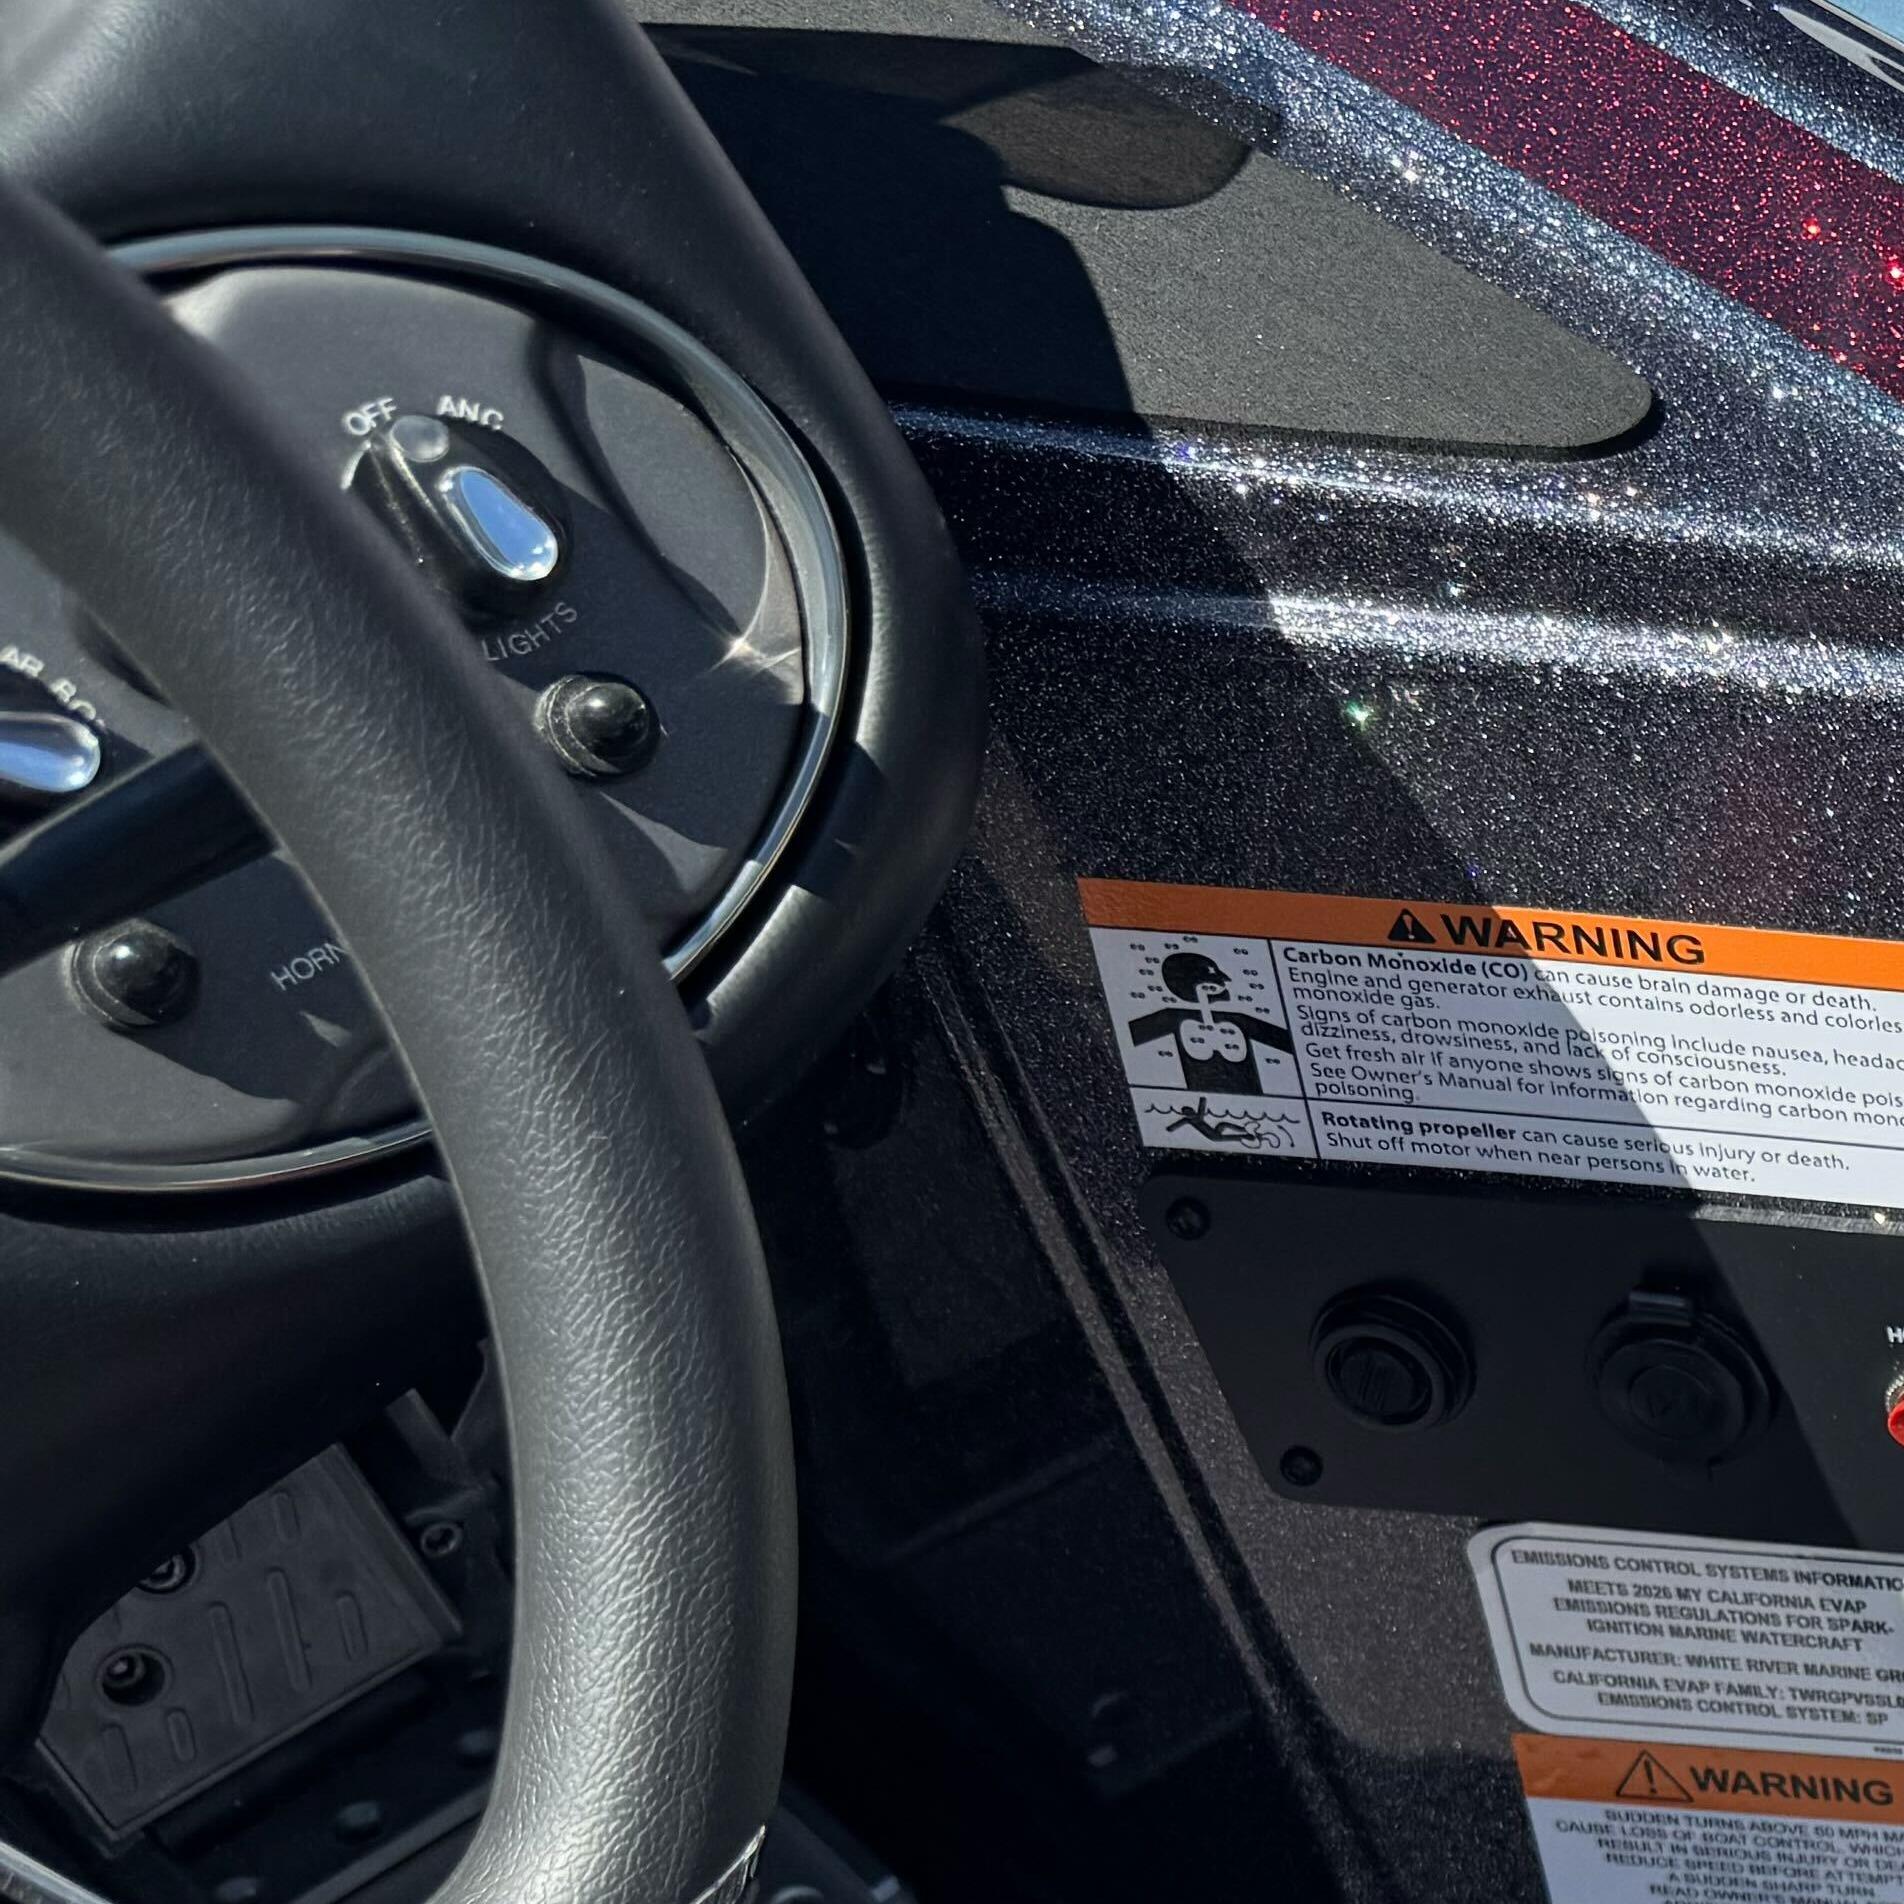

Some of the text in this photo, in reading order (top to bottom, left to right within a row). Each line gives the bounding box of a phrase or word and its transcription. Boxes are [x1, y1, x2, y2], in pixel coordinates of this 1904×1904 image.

[342, 397, 397, 435] OFF
[481, 602, 577, 661] LIGHTS
[1440, 914, 1705, 965] WARNING
[1281, 945, 1876, 1010] Carbon Monoxide (CO) can cause brain damage or death.
[1286, 967, 1360, 990] Engine
[1362, 973, 1403, 990] and
[1404, 978, 1510, 1002] generator
[1512, 986, 1592, 1006] exhaust
[1596, 993, 1684, 1014] contains
[1688, 1001, 1775, 1021] odorless
[1779, 1009, 1818, 1025] and
[1291, 983, 1441, 1013] monoxide gas.
[1294, 1004, 1352, 1027] Signs
[1352, 1009, 1378, 1025] of
[1379, 1011, 1452, 1031] carbon
[1456, 1018, 1560, 1040] monoxide
[1563, 1027, 1667, 1053] poisoning
[1671, 1036, 1746, 1056] include
[1752, 1046, 1828, 1065] nausea,
[1303, 1042, 1345, 1059] Get
[1342, 1045, 1396, 1064] fresh
[1399, 1050, 1427, 1067] air
[1429, 1053, 1445, 1068] if
[1447, 1058, 1526, 1079] anyone
[1527, 1061, 1592, 1081] shows
[1595, 1067, 1649, 1089] signs
[1652, 1072, 1673, 1088] of
[1677, 1074, 1749, 1094] carbon
[1754, 1080, 1857, 1103] monoxide
[1308, 1061, 1348, 1079] See
[1434, 1072, 1513, 1093] Manual
[1515, 1079, 1546, 1096] for
[1547, 1082, 1669, 1106] information
[1673, 1092, 1773, 1119] regarding
[1776, 1101, 1847, 1121] carbon
[1320, 1111, 1849, 1169] Rotating propeller can cause serious injury or death.
[1325, 1132, 1754, 1181] Shut off motor when near persons in water.
[1689, 1766, 1894, 1806] WARNING
